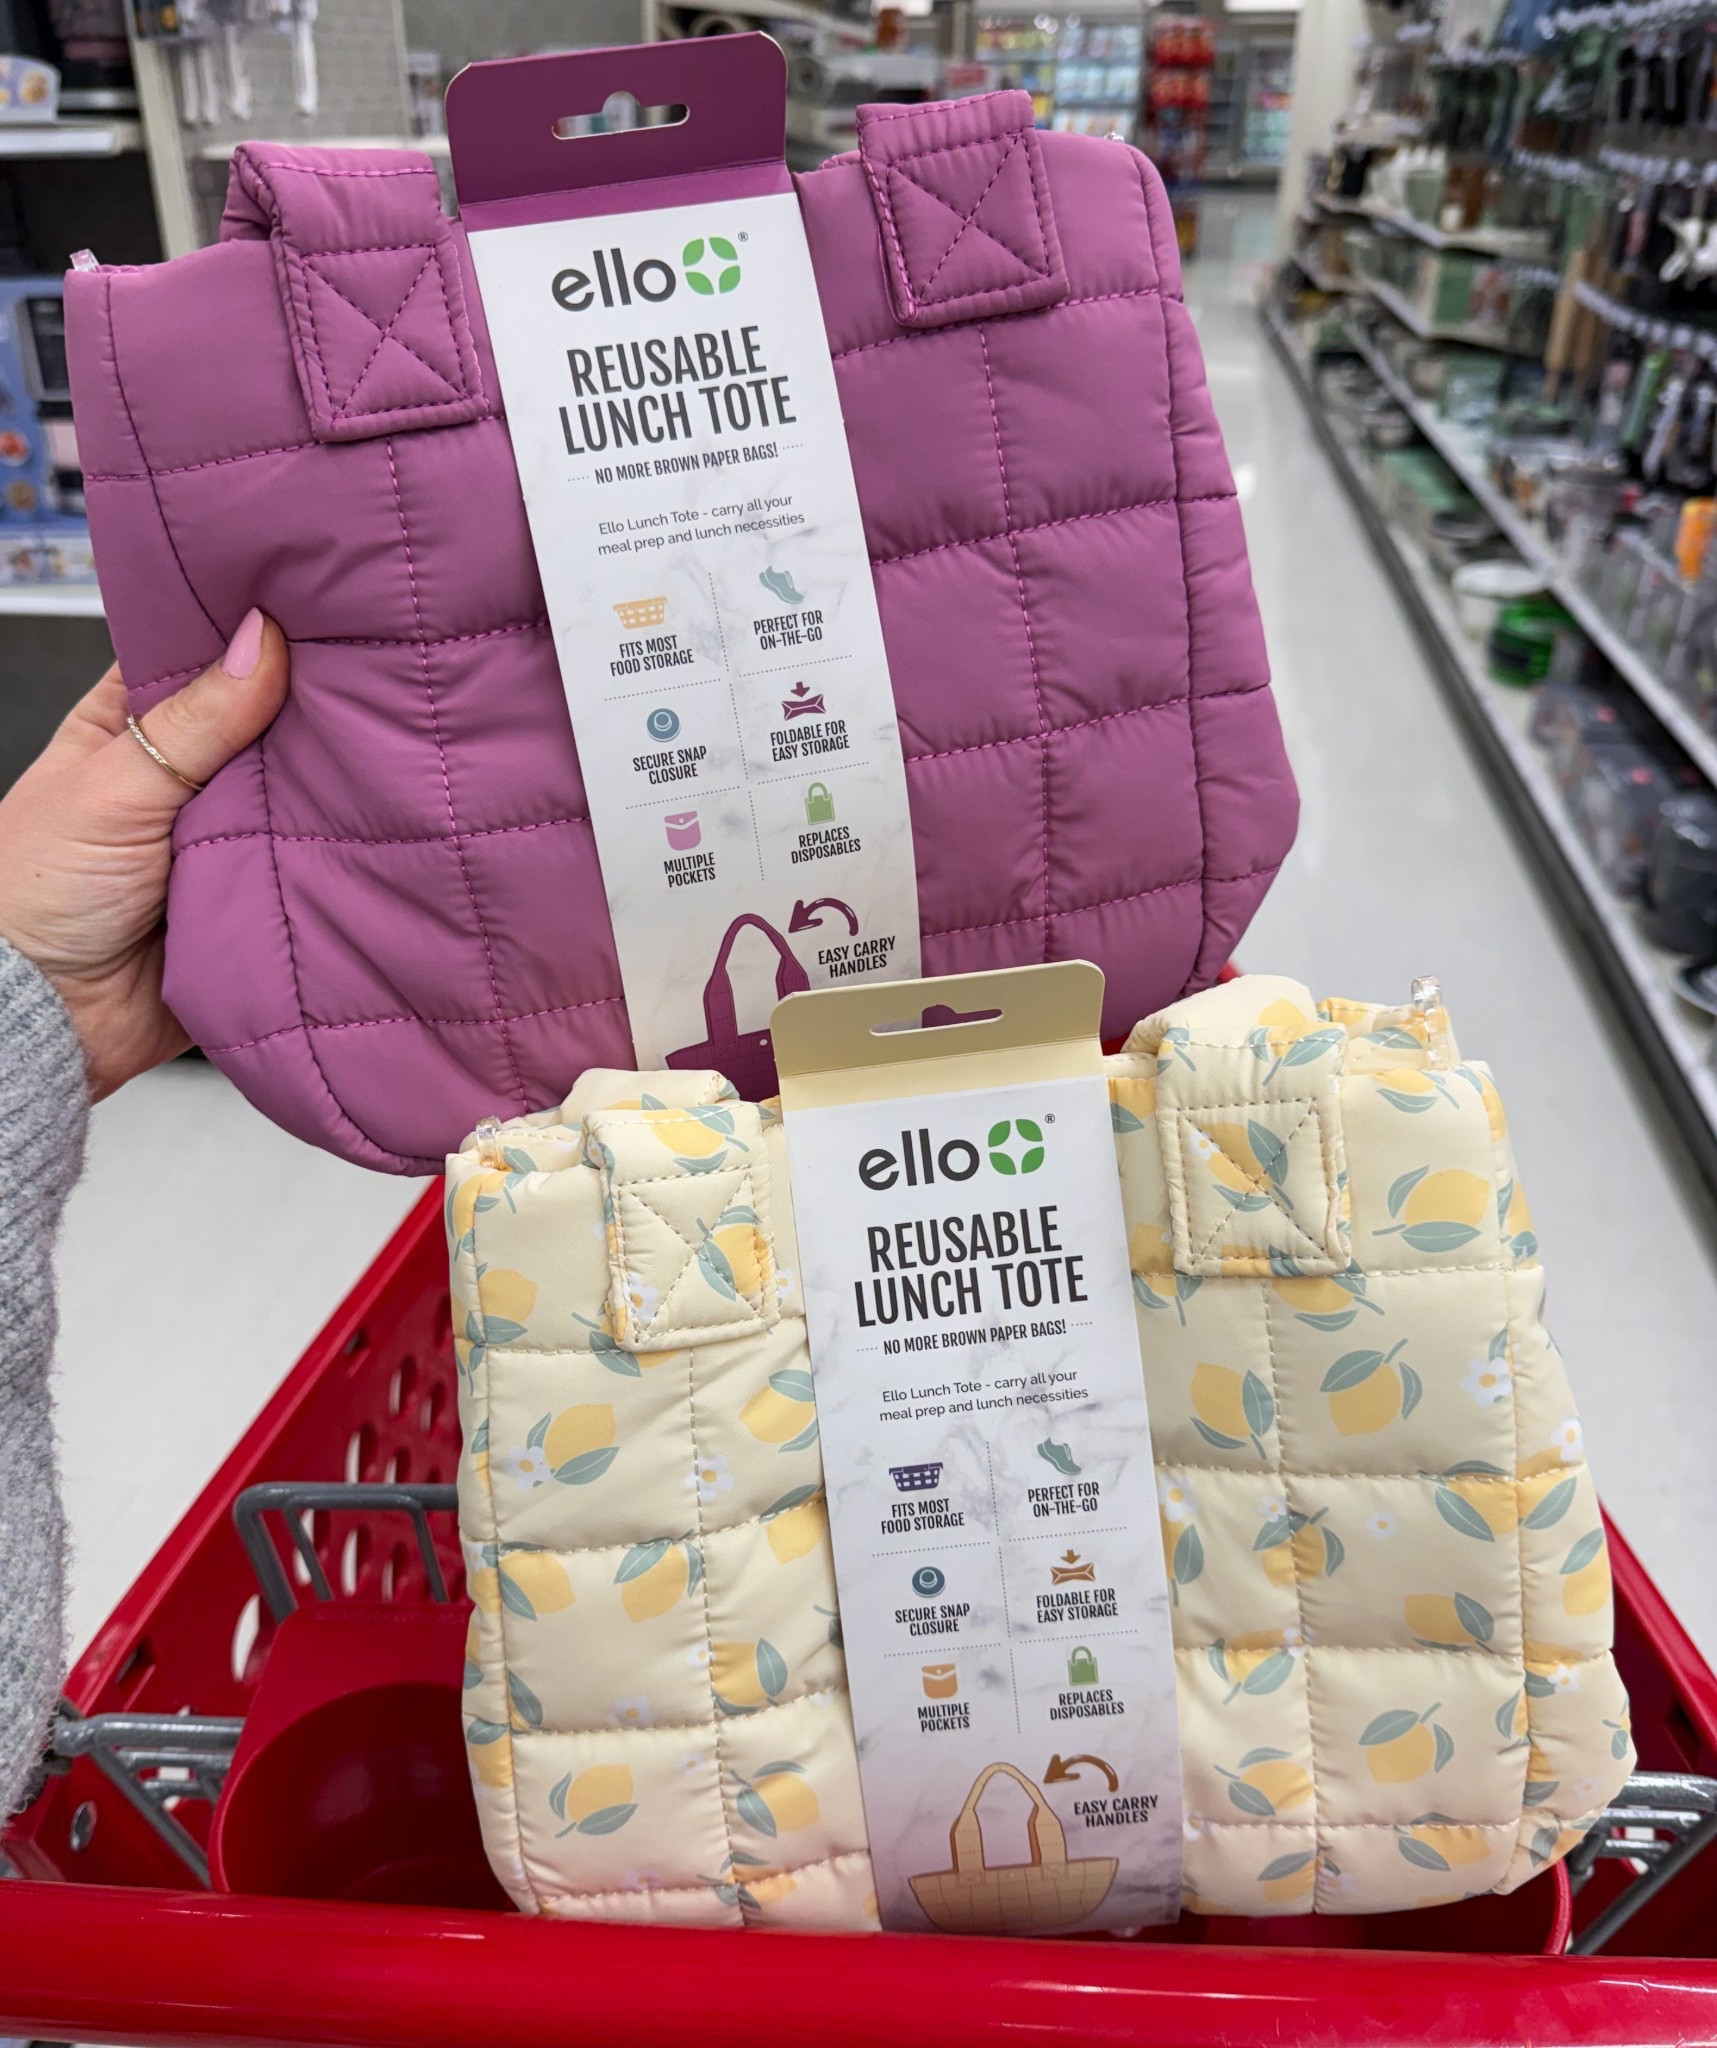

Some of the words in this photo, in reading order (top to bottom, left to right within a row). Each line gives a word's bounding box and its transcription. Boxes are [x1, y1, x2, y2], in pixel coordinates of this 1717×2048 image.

[552, 248, 676, 312] ello
[566, 325, 767, 397] REUSABLE
[559, 391, 692, 455] LUNCH
[698, 375, 796, 434] TOTE
[595, 467, 613, 484] NO
[616, 462, 652, 481] MORE
[654, 454, 700, 475] BROWN
[702, 449, 740, 468] PAPER
[742, 442, 778, 462] BAGS!
[599, 521, 624, 535] Ello
[627, 513, 669, 530] Lunch
[670, 510, 699, 523] Tote
[711, 504, 743, 517] carry
[747, 498, 763, 512] all
[764, 496, 792, 512] your
[598, 539, 632, 555] meal
[634, 537, 665, 553] prep
[668, 529, 693, 544] and
[695, 523, 732, 540] lunch
[734, 514, 805, 534] necessities
[753, 614, 798, 635] PERFECT
[801, 610, 823, 627] FOR
[619, 641, 644, 658] FITS
[646, 635, 677, 654] MOST
[760, 626, 822, 650] ON-THE-GO
[610, 658, 641, 677] FOOD
[643, 649, 694, 671] STORAGE
[770, 724, 823, 746] FOLDABLE
[825, 720, 846, 736] FOR
[633, 751, 676, 772] SECURE
[677, 745, 707, 768] SNAP
[772, 744, 798, 762] EASY
[801, 734, 850, 756] STORAGE
[649, 763, 698, 785] CLOSURE
[791, 838, 861, 864] DISPOSABLES
[798, 826, 850, 851] REPLACES
[664, 852, 715, 875] MULTIPLE
[668, 863, 716, 888] POCKETS
[818, 945, 849, 968] EASY
[854, 936, 895, 962] CARRY
[829, 948, 888, 978] HANDLES
[859, 1128, 980, 1191] ello
[867, 1205, 1062, 1273] REUSABLE
[854, 1267, 982, 1327] LUNCH
[992, 1255, 1088, 1310] TOTE
[884, 1339, 900, 1355] NO
[904, 1334, 939, 1352] MORE
[941, 1328, 987, 1348] BROWN
[990, 1324, 1027, 1342] PAPER
[1031, 1319, 1066, 1337] BAGS!
[882, 1390, 907, 1402] Ello
[910, 1384, 951, 1399] Lunch
[953, 1381, 982, 1394] Tote
[994, 1377, 1027, 1390] carry
[1030, 1372, 1047, 1385] all
[1048, 1372, 1077, 1386] your
[880, 1407, 913, 1421] meal
[915, 1406, 945, 1420] prep
[949, 1400, 973, 1413] and
[976, 1395, 1013, 1410] lunch
[1016, 1389, 1088, 1405] necessities
[1028, 1484, 1074, 1503] PERFECT
[1077, 1482, 1100, 1497] FOR
[892, 1502, 915, 1518] FITS
[918, 1498, 949, 1515] MOST
[1033, 1497, 1098, 1517] ON-THE-GO
[881, 1513, 911, 1534] FOOD
[914, 1510, 965, 1531] STORAGE
[1036, 1590, 1091, 1609] FOLDABLE
[1094, 1588, 1116, 1603] FOR
[895, 1606, 937, 1623] SECURE
[940, 1603, 970, 1618] SNAP
[1037, 1603, 1064, 1623] EASY
[1068, 1602, 1118, 1620] STORAGE
[910, 1616, 959, 1636] CLOSURE
[1050, 1698, 1124, 1720] DISPOSABLES
[1059, 1689, 1113, 1706] REPLACES
[918, 1702, 970, 1719] MULTIPLE
[921, 1712, 970, 1732] POCKETS
[1074, 1800, 1107, 1815] EASY
[1113, 1795, 1158, 1815] CARRY
[1086, 1810, 1148, 1828] HANDLES
